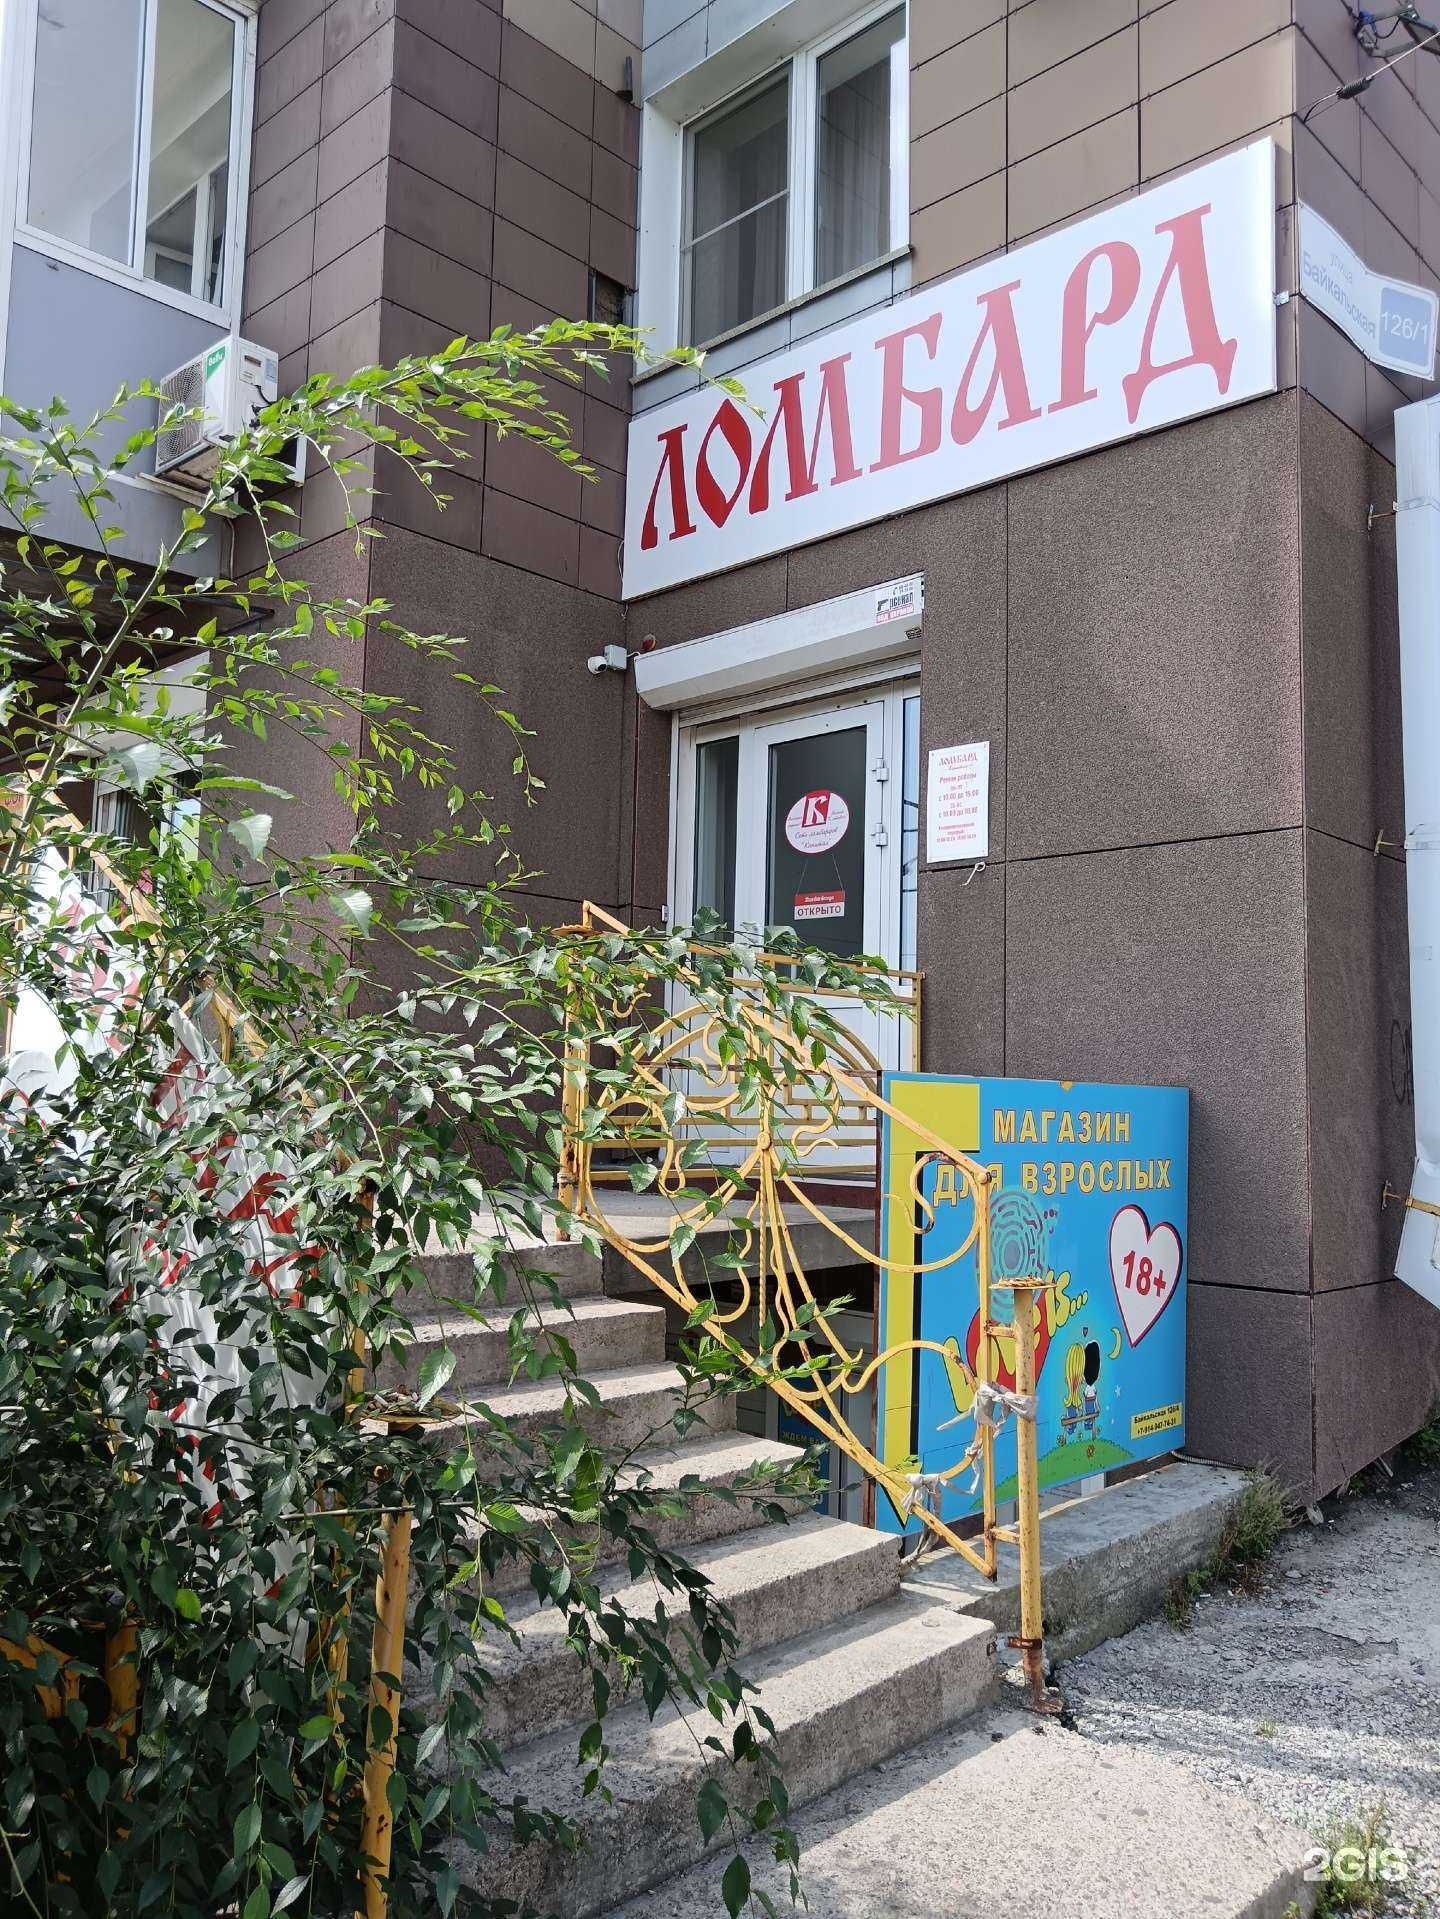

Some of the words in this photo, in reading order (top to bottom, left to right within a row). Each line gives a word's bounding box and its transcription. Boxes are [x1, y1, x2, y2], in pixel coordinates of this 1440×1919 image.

[1302, 250, 1377, 339] Байкальская
[1381, 311, 1429, 345] 126/1
[640, 202, 1238, 552] ЛОМБАРД
[797, 904, 842, 917] ОТКРЫТО
[993, 1109, 1131, 1143] МАГАЗИН
[1021, 1159, 1172, 1196] ВЗРОСЛЫХ
[1122, 1249, 1167, 1298] 18+
